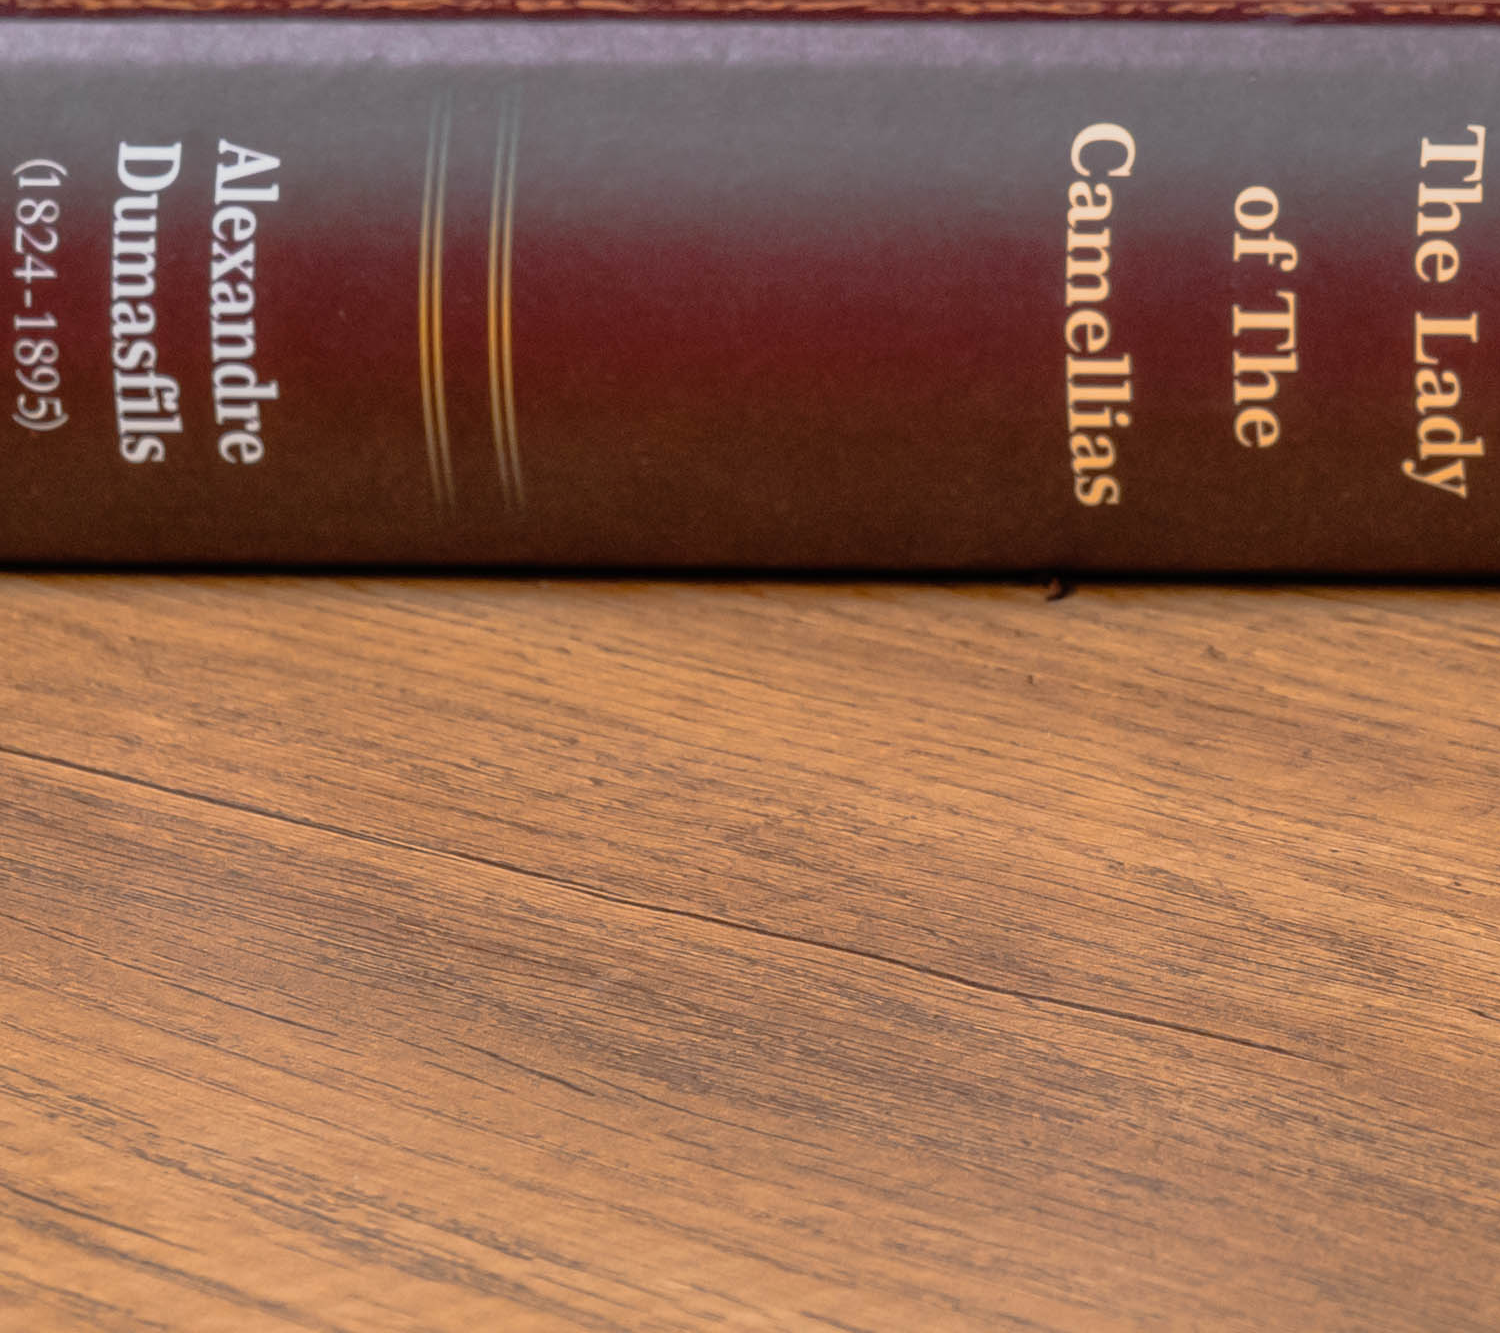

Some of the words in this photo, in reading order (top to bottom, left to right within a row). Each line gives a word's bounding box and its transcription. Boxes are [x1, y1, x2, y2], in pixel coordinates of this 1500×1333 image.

[12, 158, 69, 432] (1824-1895)
[112, 141, 183, 464] Dumasfils
[210, 138, 281, 465] Alexandre
[1064, 122, 1136, 508] Camellias
[1233, 184, 1299, 272] of
[1413, 125, 1487, 285] The
[1232, 291, 1299, 449] The
[1401, 310, 1485, 498] Lady
